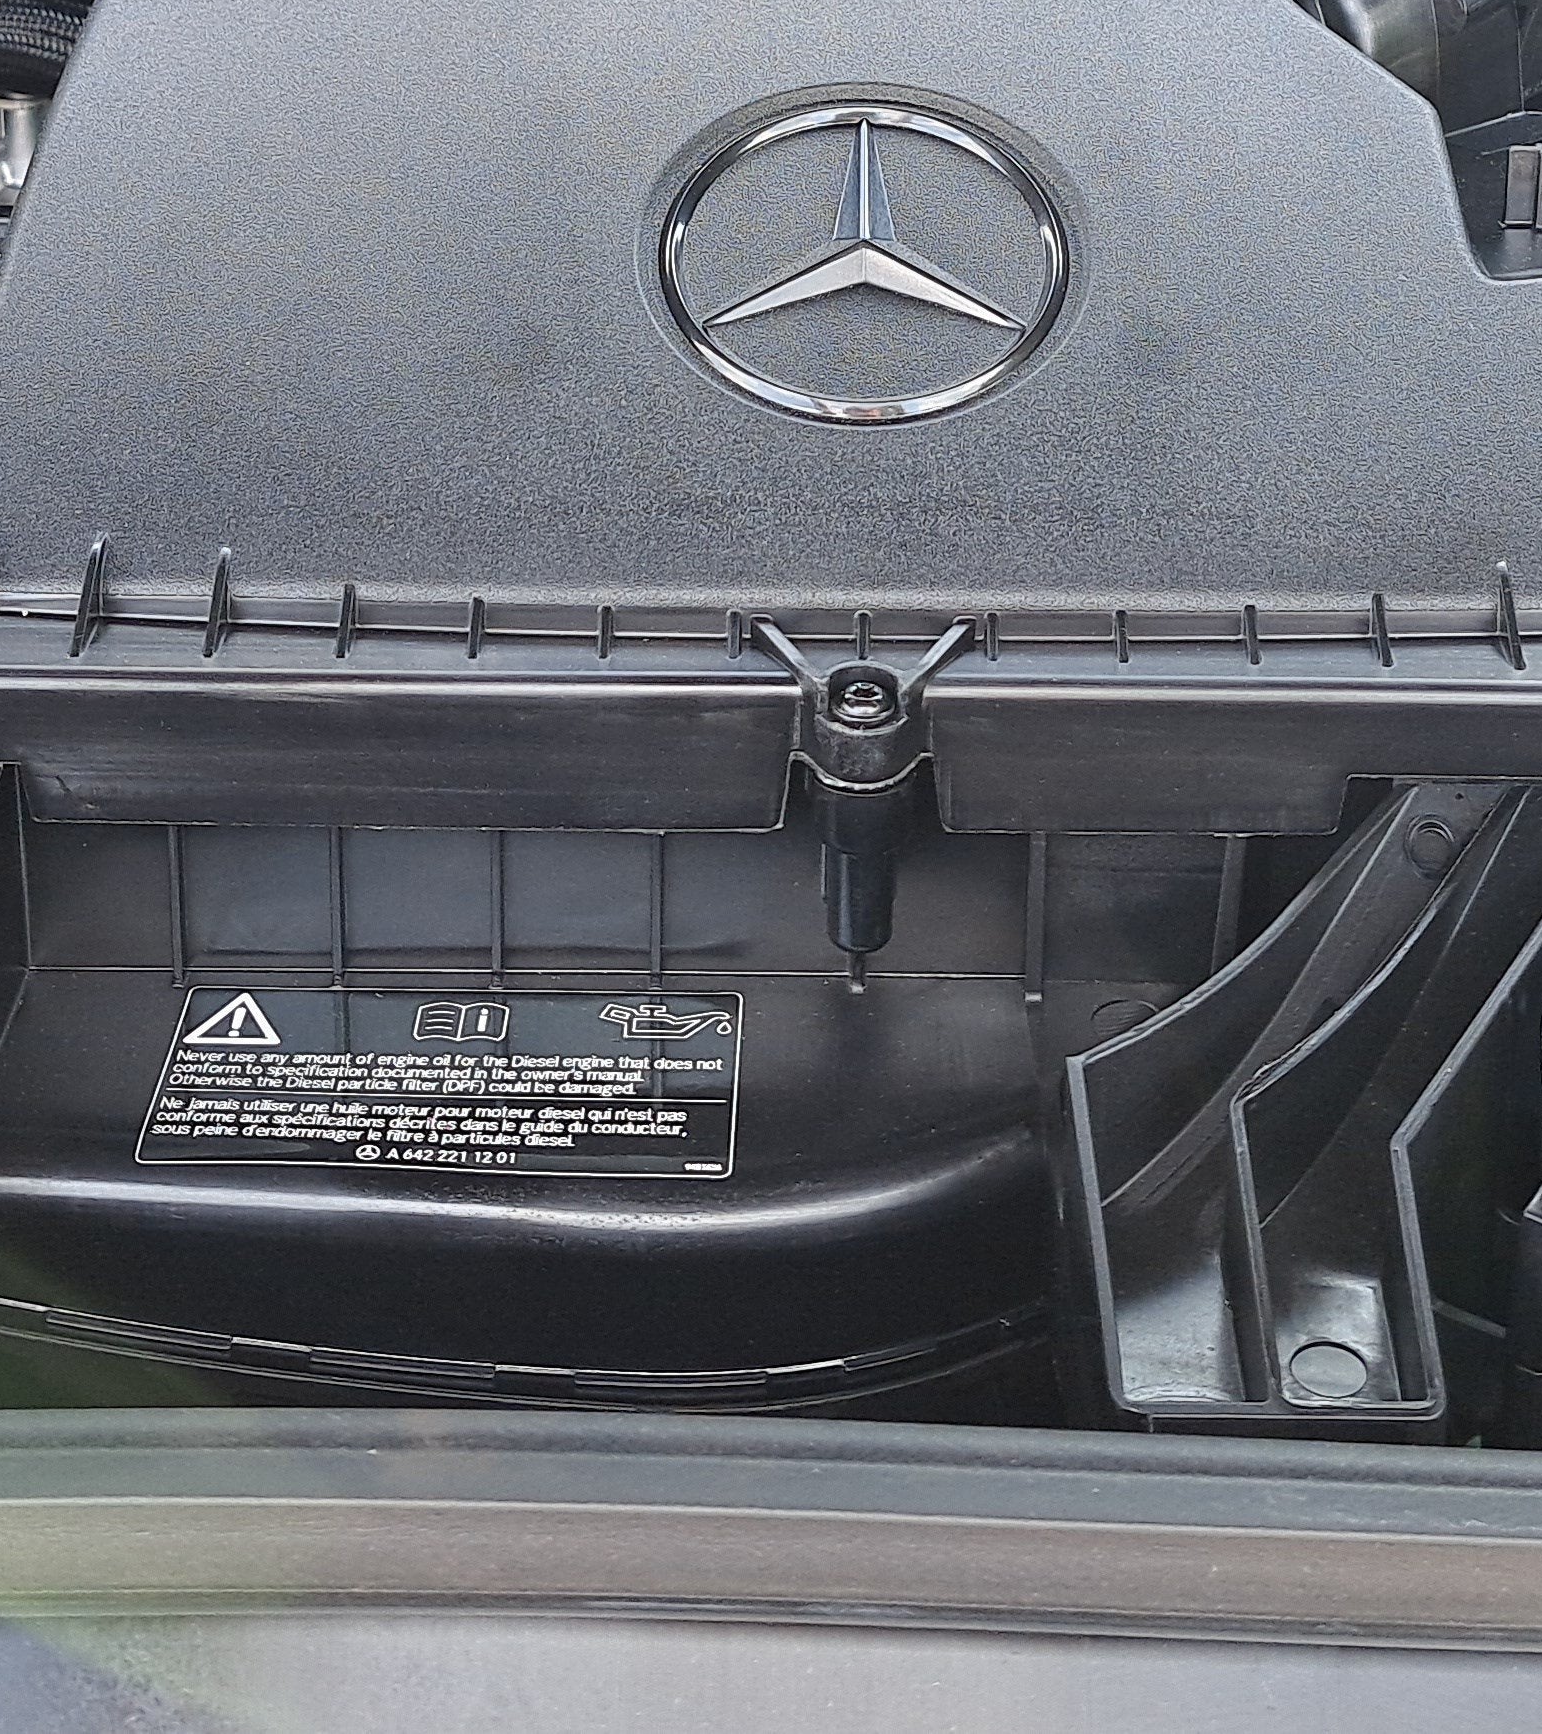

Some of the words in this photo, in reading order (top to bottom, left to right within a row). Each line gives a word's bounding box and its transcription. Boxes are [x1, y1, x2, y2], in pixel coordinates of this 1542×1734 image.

[172, 1062, 241, 1074] conform
[246, 1064, 263, 1075] to
[266, 1064, 367, 1079] specification
[371, 1066, 471, 1079] documented
[474, 1067, 487, 1079] in
[491, 1068, 517, 1080] the
[521, 1068, 583, 1081] owner's
[176, 1049, 225, 1063] Never
[228, 1053, 257, 1063] use
[260, 1053, 287, 1067] any
[290, 1053, 351, 1065] amount
[356, 1053, 374, 1065] of
[377, 1054, 429, 1069] engine
[433, 1054, 451, 1066] oil
[454, 1055, 478, 1066] for
[483, 1055, 508, 1067] the
[512, 1055, 560, 1068] Diesel
[562, 1057, 614, 1072] engine
[619, 1056, 650, 1069] that
[654, 1057, 692, 1070] does
[696, 1059, 723, 1071] not
[168, 1073, 252, 1086] Otherwise
[256, 1075, 282, 1087] the
[285, 1076, 334, 1089] Diesel
[336, 1077, 397, 1093] particle
[401, 1078, 439, 1091] filter
[442, 1079, 485, 1094] (DPF)
[488, 1081, 531, 1093] could
[534, 1082, 555, 1093] be
[159, 1095, 184, 1109] Ne
[186, 1097, 240, 1111] jamais
[243, 1099, 296, 1112] utiliser
[299, 1103, 329, 1114] une
[332, 1102, 368, 1114] huile
[371, 1104, 430, 1116] moteur
[433, 1107, 472, 1120] pour
[475, 1107, 534, 1120] moteur
[538, 1106, 585, 1120] diesel
[587, 1108, 612, 1124] qui
[615, 1108, 654, 1121] n'est
[657, 1111, 688, 1125] pas
[156, 1110, 237, 1123] conforme
[240, 1113, 268, 1124] aux
[271, 1112, 386, 1130] spécifications
[389, 1116, 457, 1131] décrites
[460, 1118, 499, 1131] dans
[501, 1119, 516, 1132] le
[519, 1121, 564, 1136] guide
[567, 1122, 588, 1133] du
[151, 1123, 191, 1134] sous
[193, 1124, 240, 1138] peine
[242, 1125, 362, 1143] d'endommager
[366, 1128, 382, 1141] le
[385, 1130, 426, 1143] filtre
[428, 1130, 439, 1143] à
[441, 1132, 521, 1147] particules
[386, 1150, 400, 1161] A
[403, 1149, 435, 1162] 642
[437, 1150, 467, 1163] 221
[474, 1152, 494, 1164] 12
[496, 1152, 516, 1164] 01
